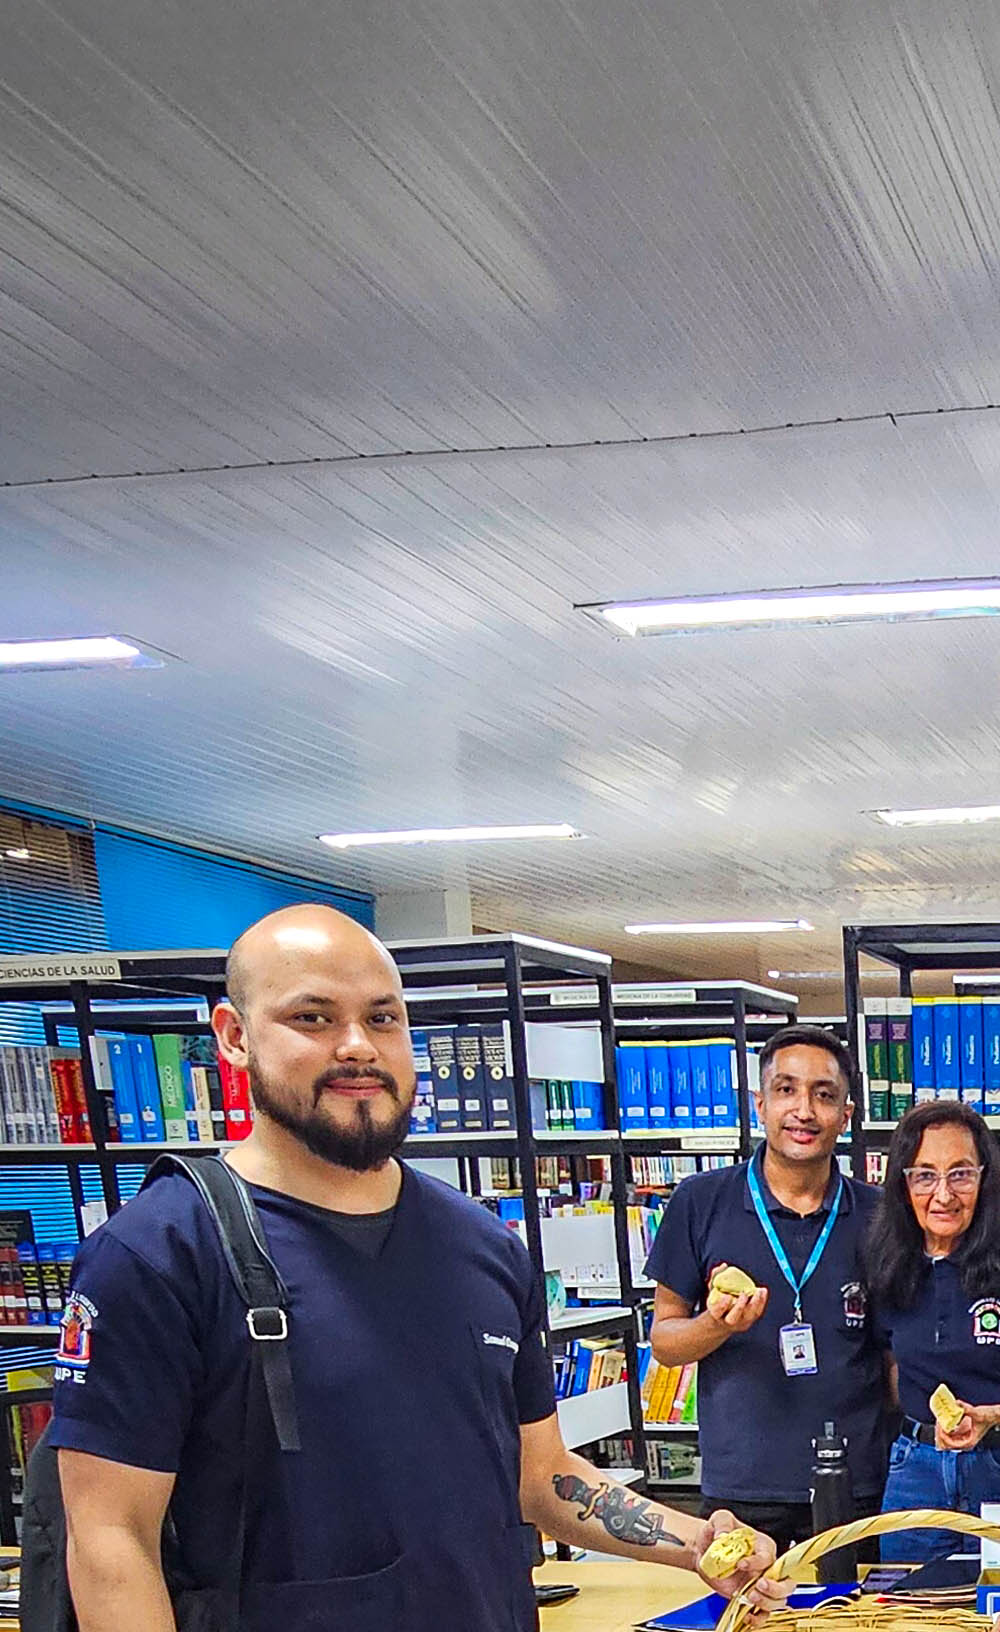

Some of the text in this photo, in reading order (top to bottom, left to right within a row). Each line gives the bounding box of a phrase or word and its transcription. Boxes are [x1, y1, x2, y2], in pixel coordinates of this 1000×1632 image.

[47, 966, 62, 976] DE
[64, 966, 78, 975] LA
[80, 965, 116, 975] SALUD
